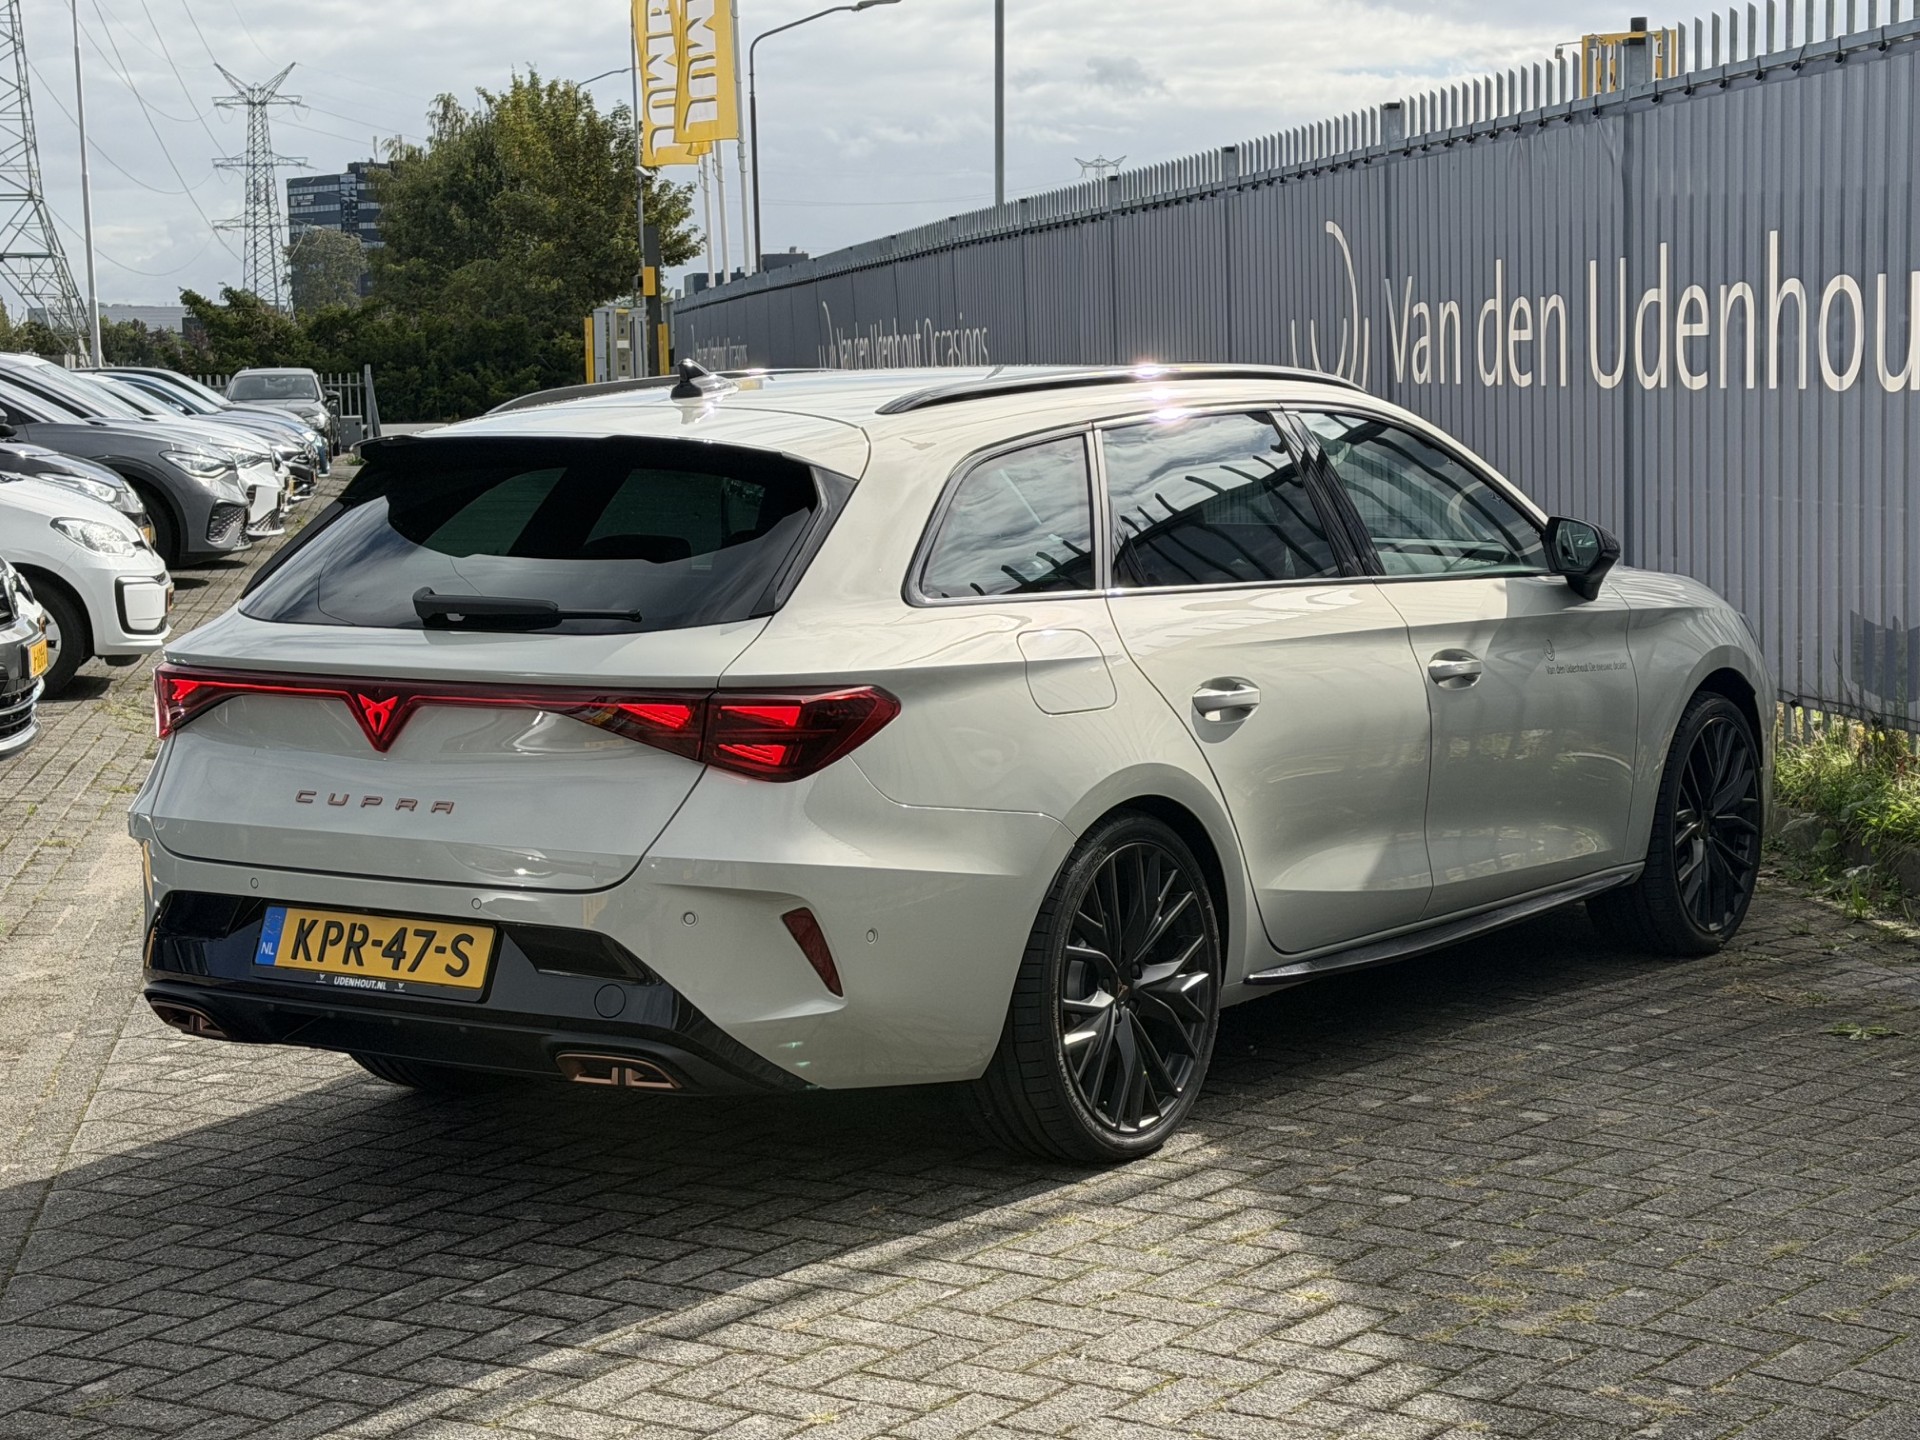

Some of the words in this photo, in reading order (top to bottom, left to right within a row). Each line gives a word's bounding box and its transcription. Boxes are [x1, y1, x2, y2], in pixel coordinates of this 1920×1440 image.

[1384, 275, 1462, 385] Van
[1477, 258, 1567, 388] den
[1589, 230, 1920, 393] Udenhou
[836, 327, 853, 370] Van
[854, 321, 870, 369] den
[870, 317, 921, 369] Udenhout
[924, 311, 989, 368] Occasions
[295, 789, 455, 815] CUPRA
[260, 941, 275, 956] NL
[290, 917, 475, 978] KPR-47-S
[333, 976, 388, 991] UDENHOUT.NL
